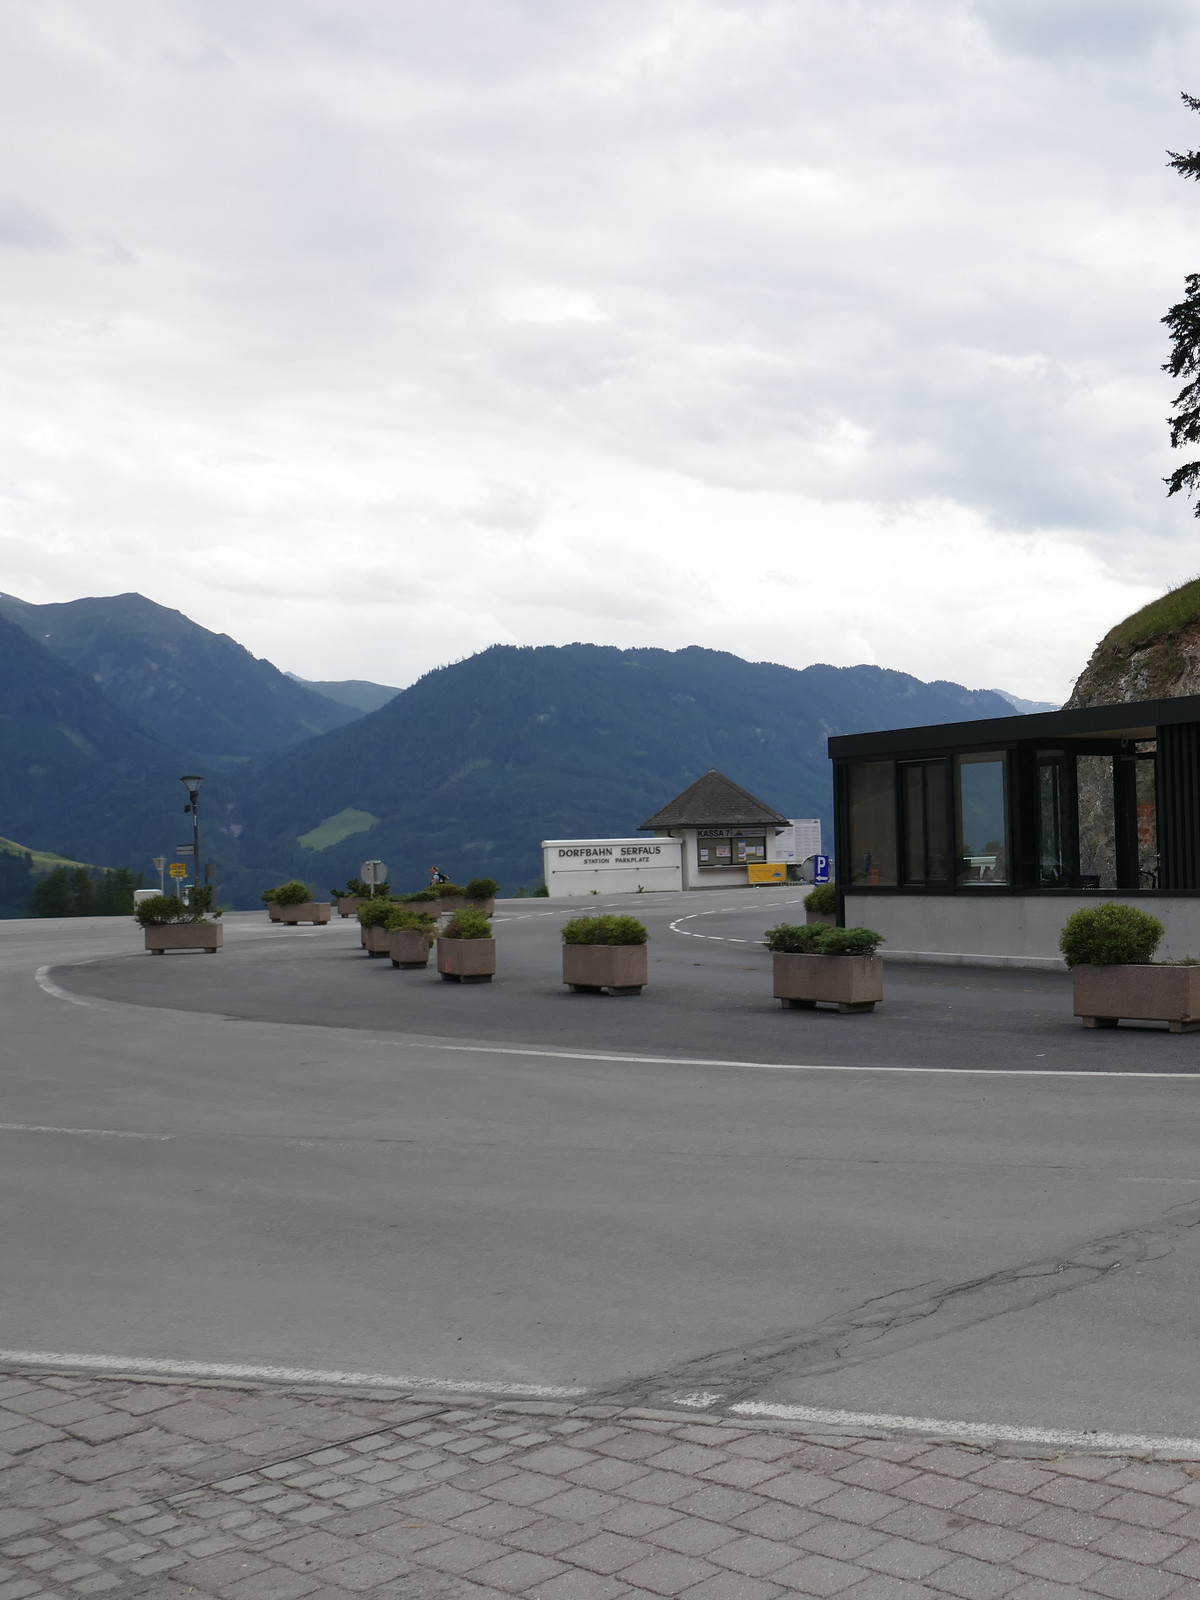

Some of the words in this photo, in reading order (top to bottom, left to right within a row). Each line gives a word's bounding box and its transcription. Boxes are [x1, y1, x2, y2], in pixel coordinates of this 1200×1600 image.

[698, 829, 723, 837] KASSA
[725, 829, 730, 837] 7
[558, 848, 613, 858] DORFBAHN
[620, 846, 661, 856] SERFAUS
[615, 856, 649, 864] PARKPLATZ
[817, 856, 826, 874] P
